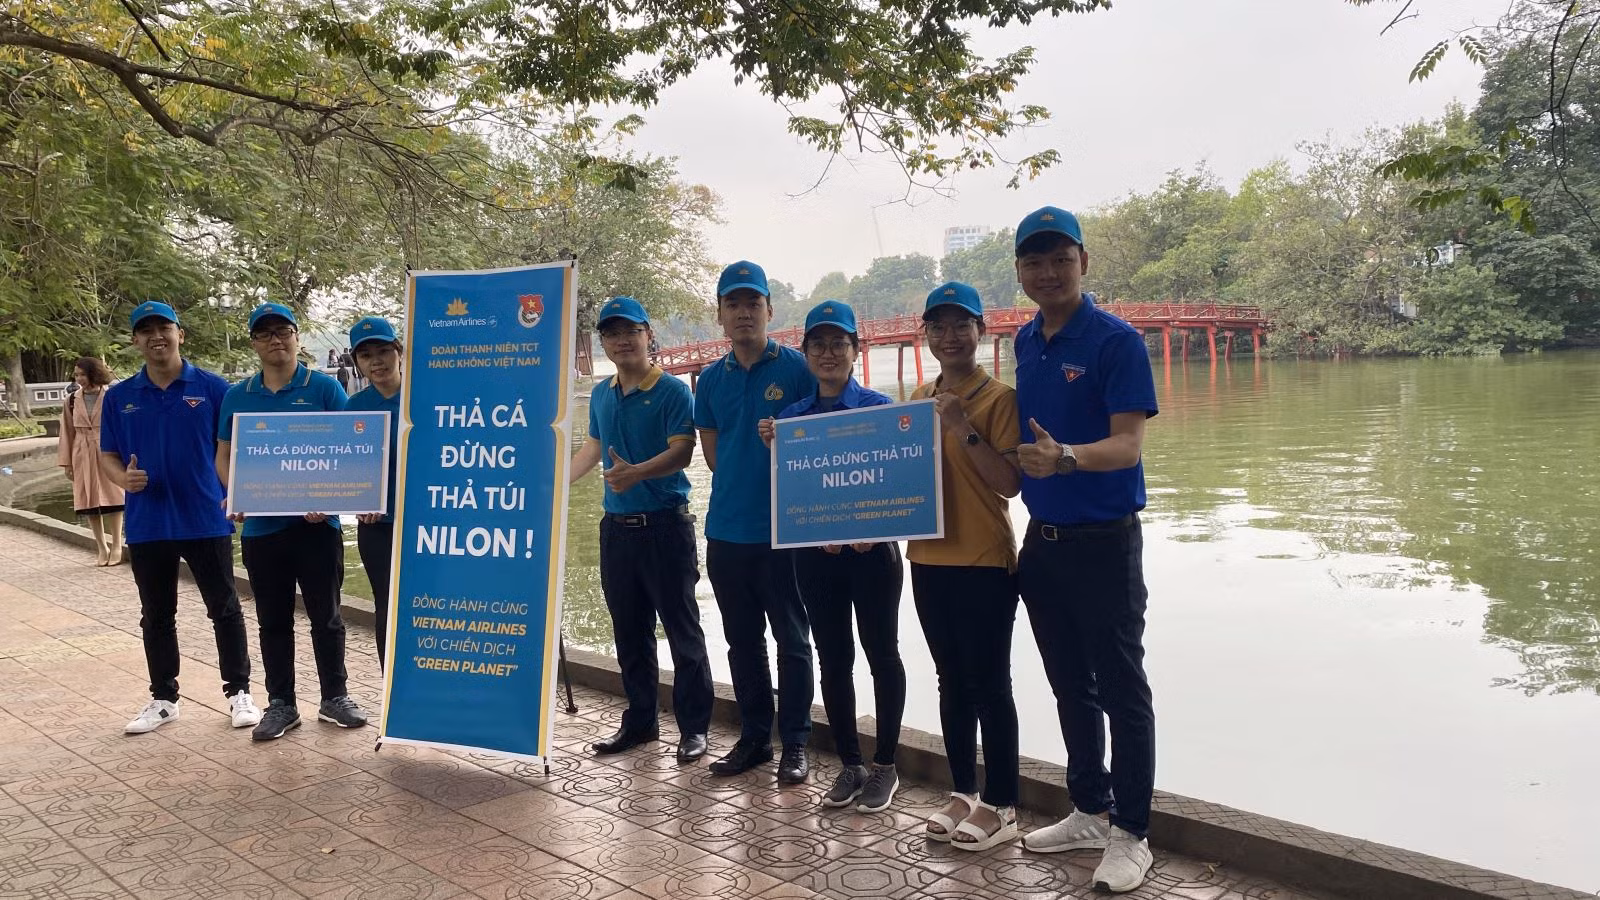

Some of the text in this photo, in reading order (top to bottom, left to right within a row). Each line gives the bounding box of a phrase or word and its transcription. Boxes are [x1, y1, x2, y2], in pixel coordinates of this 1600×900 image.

[432, 342, 540, 355] ĐOÀN THANH NIÊN TCT
[494, 356, 514, 369] VIỆT
[517, 356, 540, 366] NAM
[435, 398, 528, 428] THẢ CÁ
[246, 442, 373, 455] THẢ CÁ ĐỪNG THẢ TÚI
[441, 440, 516, 468] ĐỪNG
[786, 444, 922, 471] THẢ CÁ ĐỪNG THẢ TÚI
[280, 460, 338, 471] NILON !
[822, 468, 884, 488] NILON !
[428, 478, 526, 510] THẢ TÚI
[854, 500, 888, 508] VIETNAM
[890, 496, 925, 506] AIRLINES
[416, 526, 534, 558] NILON !
[412, 593, 528, 616] ĐỒNG HÀNH CÙNG
[412, 616, 527, 636] VIETNAM AIRLINES
[418, 635, 438, 650] VỚI
[483, 642, 516, 657] DỊCH
